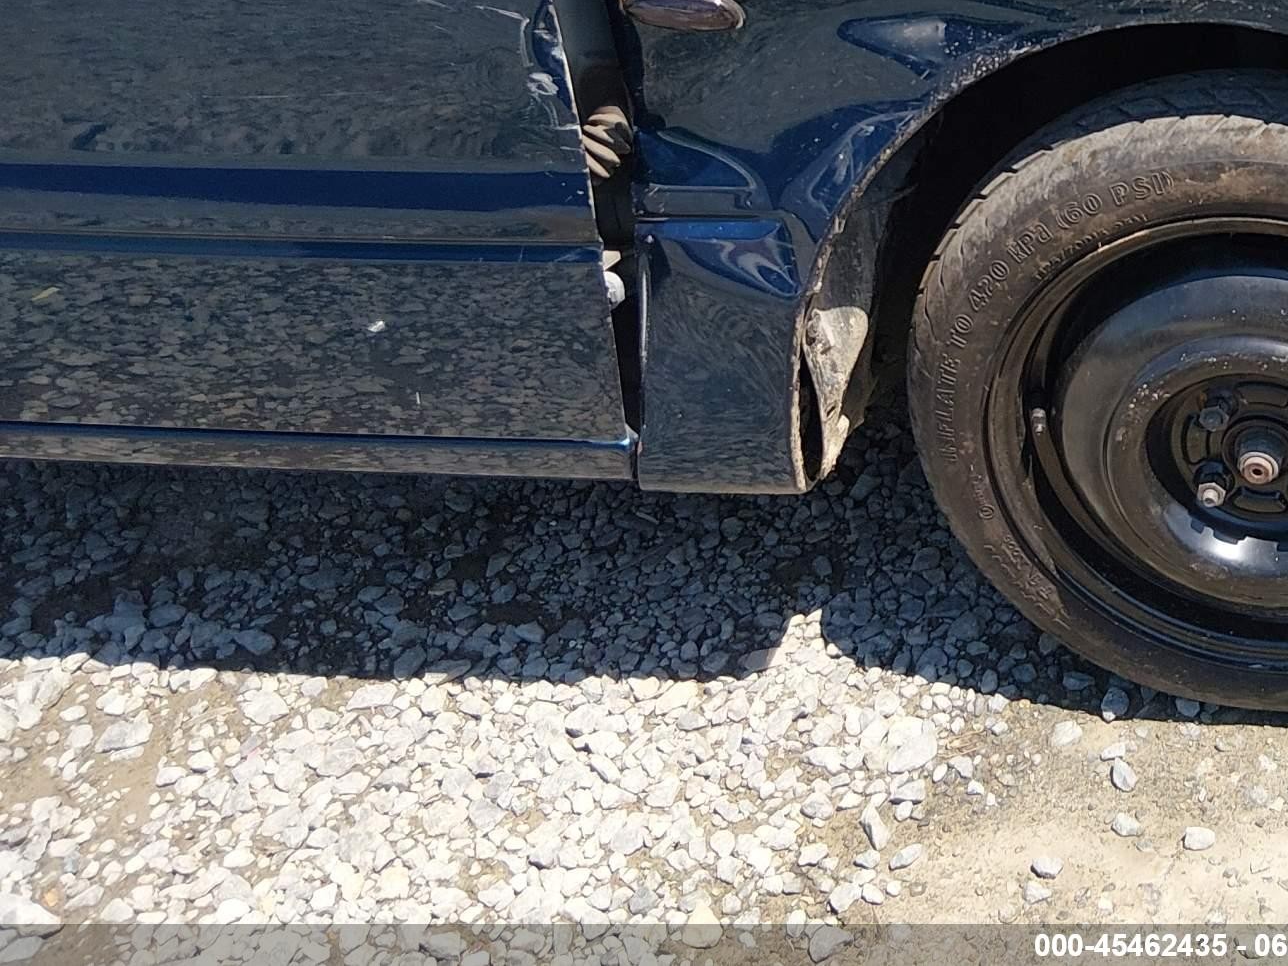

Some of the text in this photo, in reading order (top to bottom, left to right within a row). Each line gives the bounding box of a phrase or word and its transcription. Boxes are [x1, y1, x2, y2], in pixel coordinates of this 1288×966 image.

[936, 169, 1175, 462] INFLATE TO 420 kPa (60 PSI)
